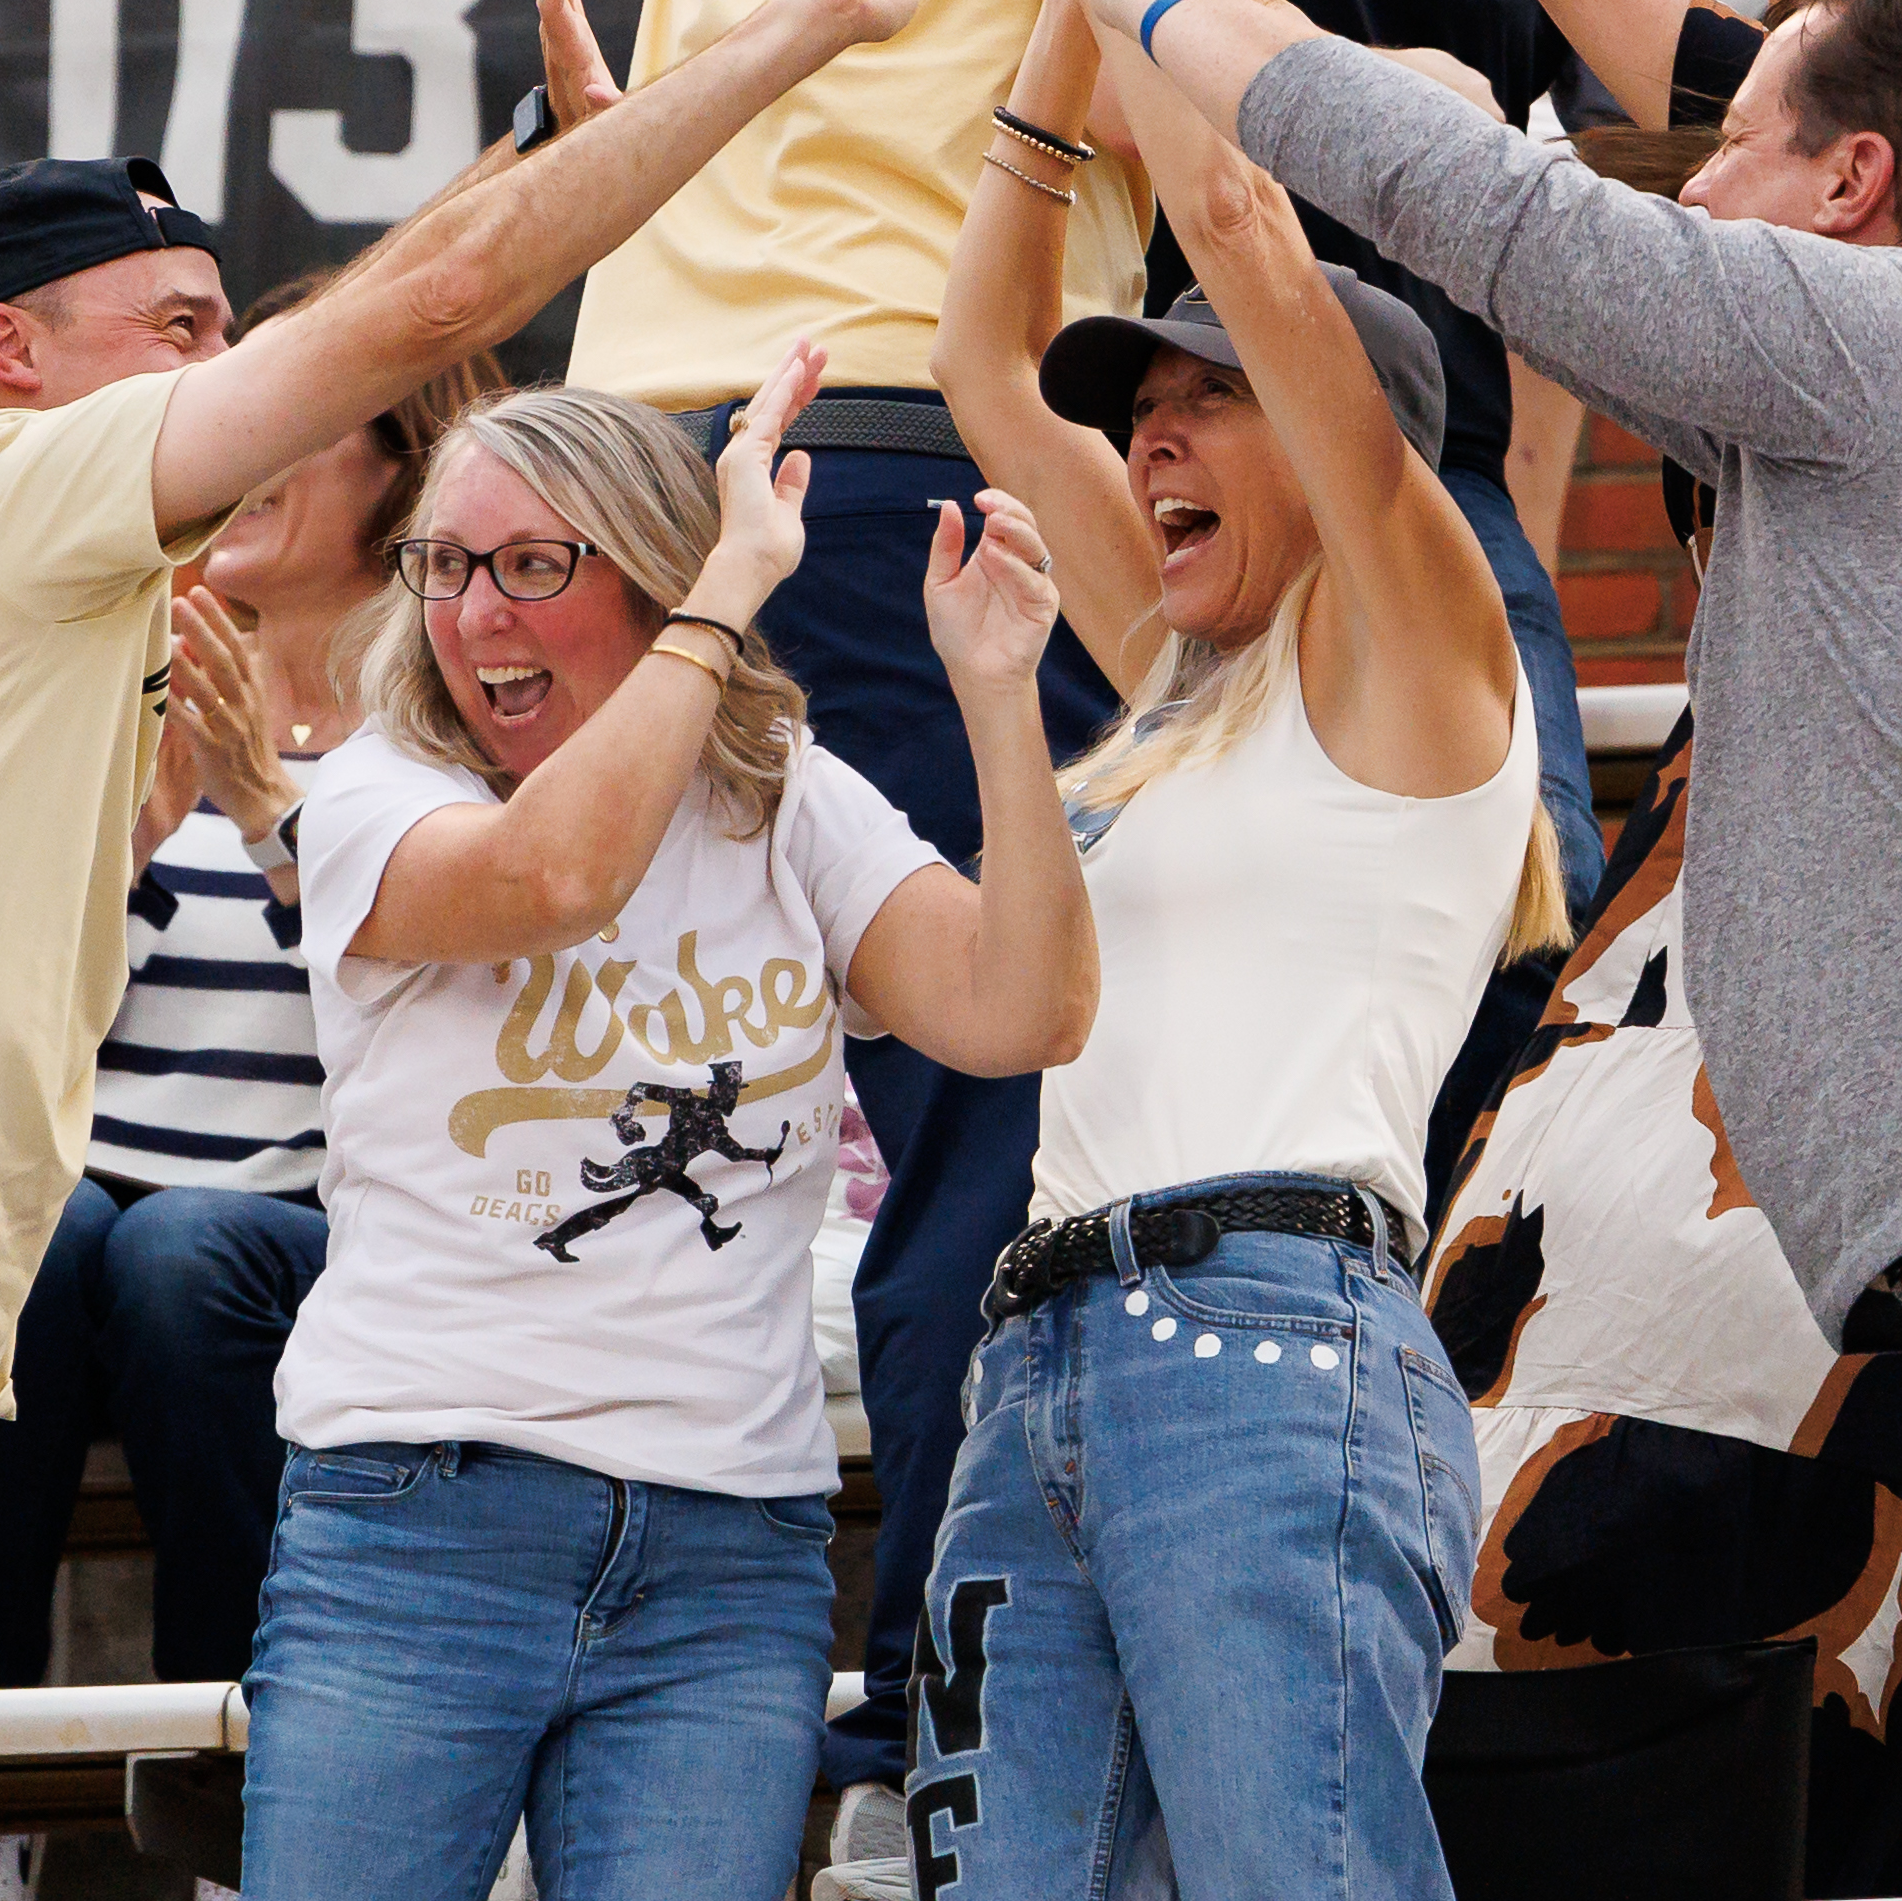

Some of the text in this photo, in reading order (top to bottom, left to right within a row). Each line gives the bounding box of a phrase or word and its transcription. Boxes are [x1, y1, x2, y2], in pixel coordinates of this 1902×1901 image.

[492, 930, 829, 1083] Wake
[516, 1169, 552, 1198] GO
[470, 1195, 562, 1228] DEACS
